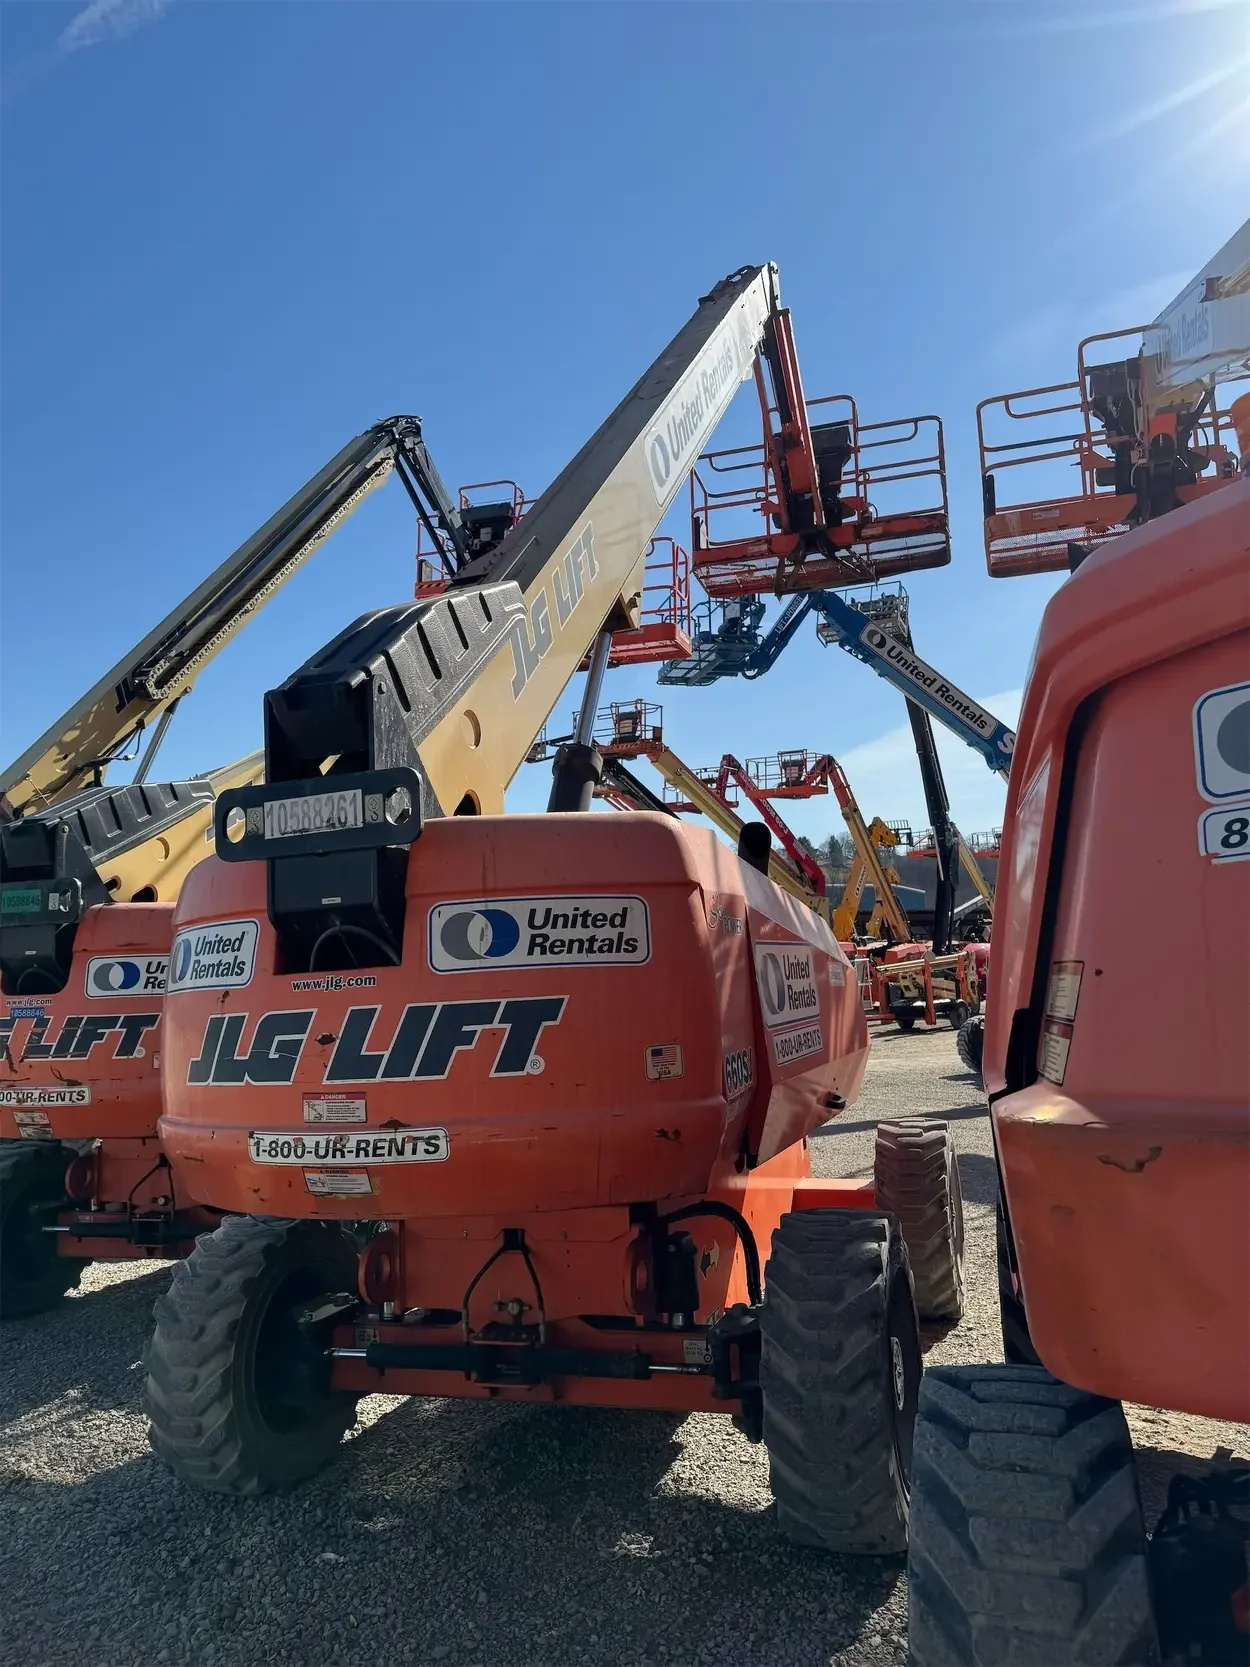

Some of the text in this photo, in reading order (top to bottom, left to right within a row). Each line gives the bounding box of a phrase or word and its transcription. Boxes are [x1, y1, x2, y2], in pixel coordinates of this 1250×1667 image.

[667, 339, 733, 461] United Rentals
[510, 520, 595, 704] JLG LIFT
[887, 645, 988, 730] United Rentals
[266, 791, 360, 837] 10588261
[527, 907, 629, 930] United
[194, 932, 246, 957] United
[526, 932, 639, 956] Rentals
[190, 955, 246, 980] Rentals
[783, 955, 810, 980] United
[292, 975, 376, 991] www.jlg.com
[787, 985, 817, 1011] Rentals
[20, 1013, 162, 1061] LIFT
[186, 995, 570, 1086] JLG LIFT
[253, 1135, 441, 1159] 1-800-UR-RENTS
